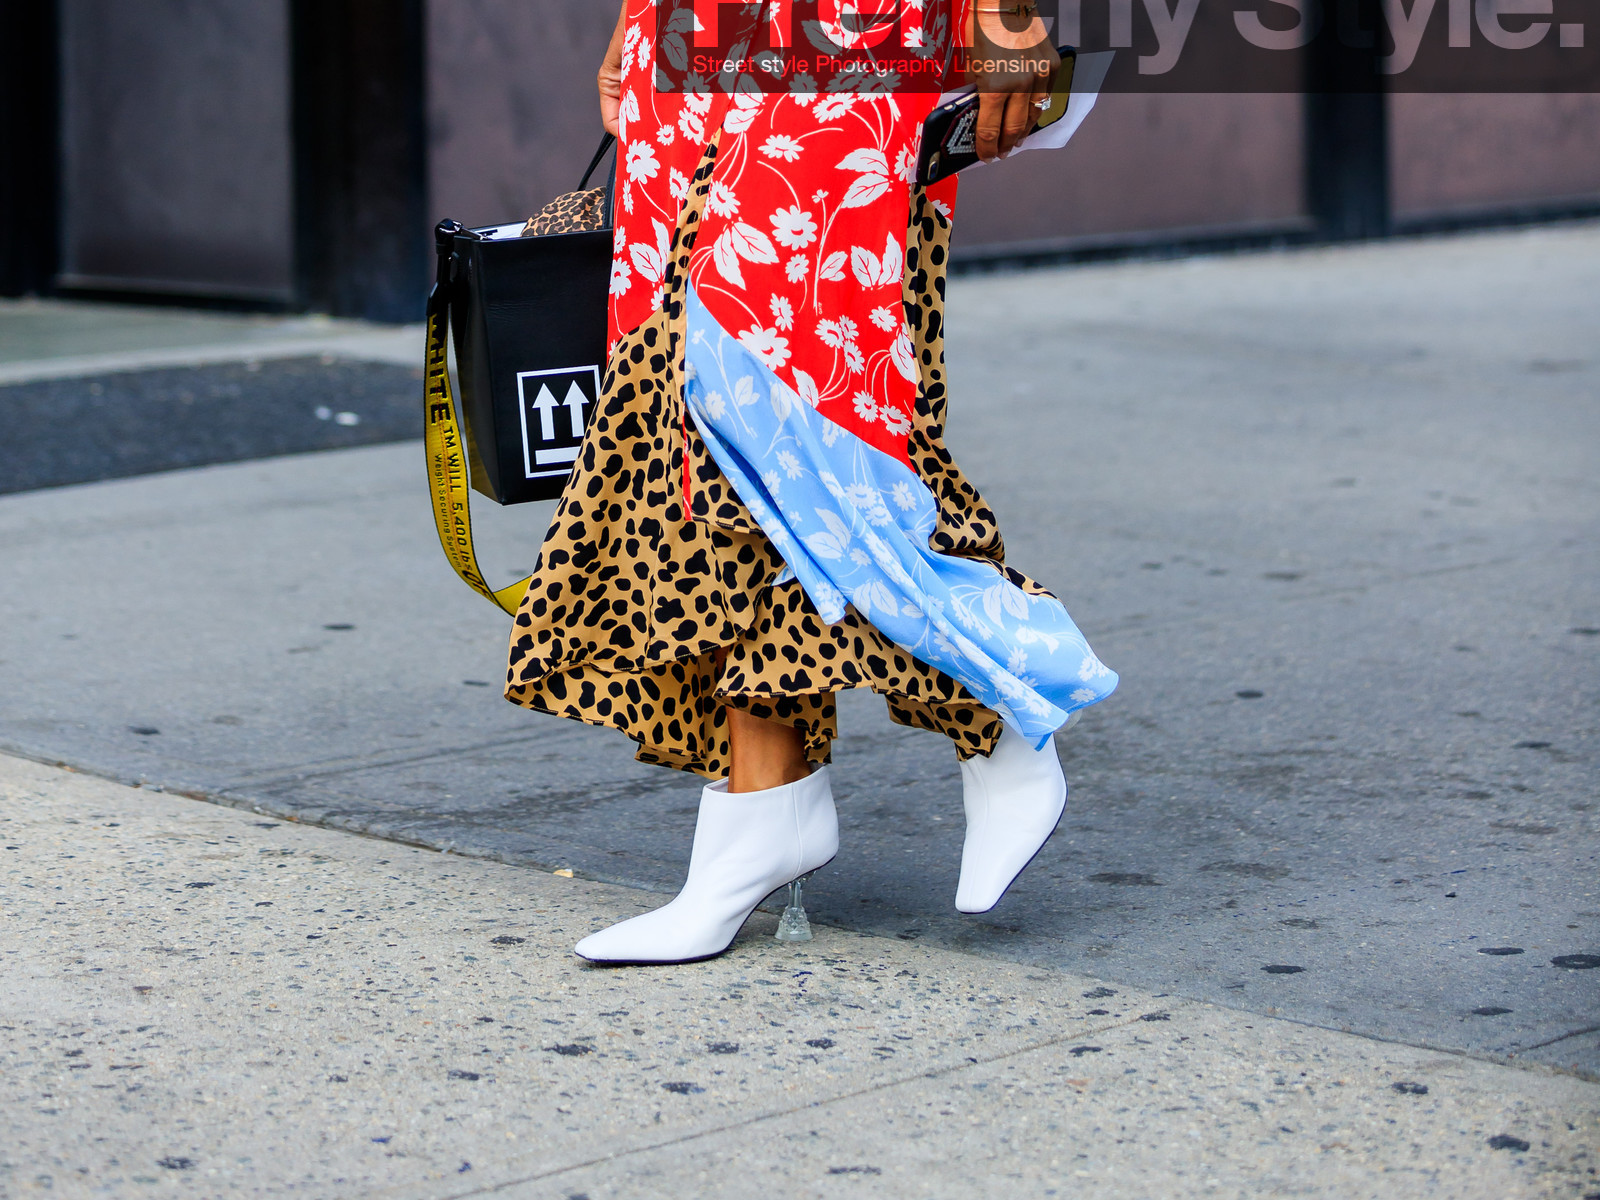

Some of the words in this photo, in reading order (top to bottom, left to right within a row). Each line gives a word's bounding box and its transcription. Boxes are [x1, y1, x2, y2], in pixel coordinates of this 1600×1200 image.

[435, 453, 446, 487] Weight
[448, 453, 462, 492] WILL
[439, 490, 451, 533] Securing
[452, 503, 467, 546] 5,400
